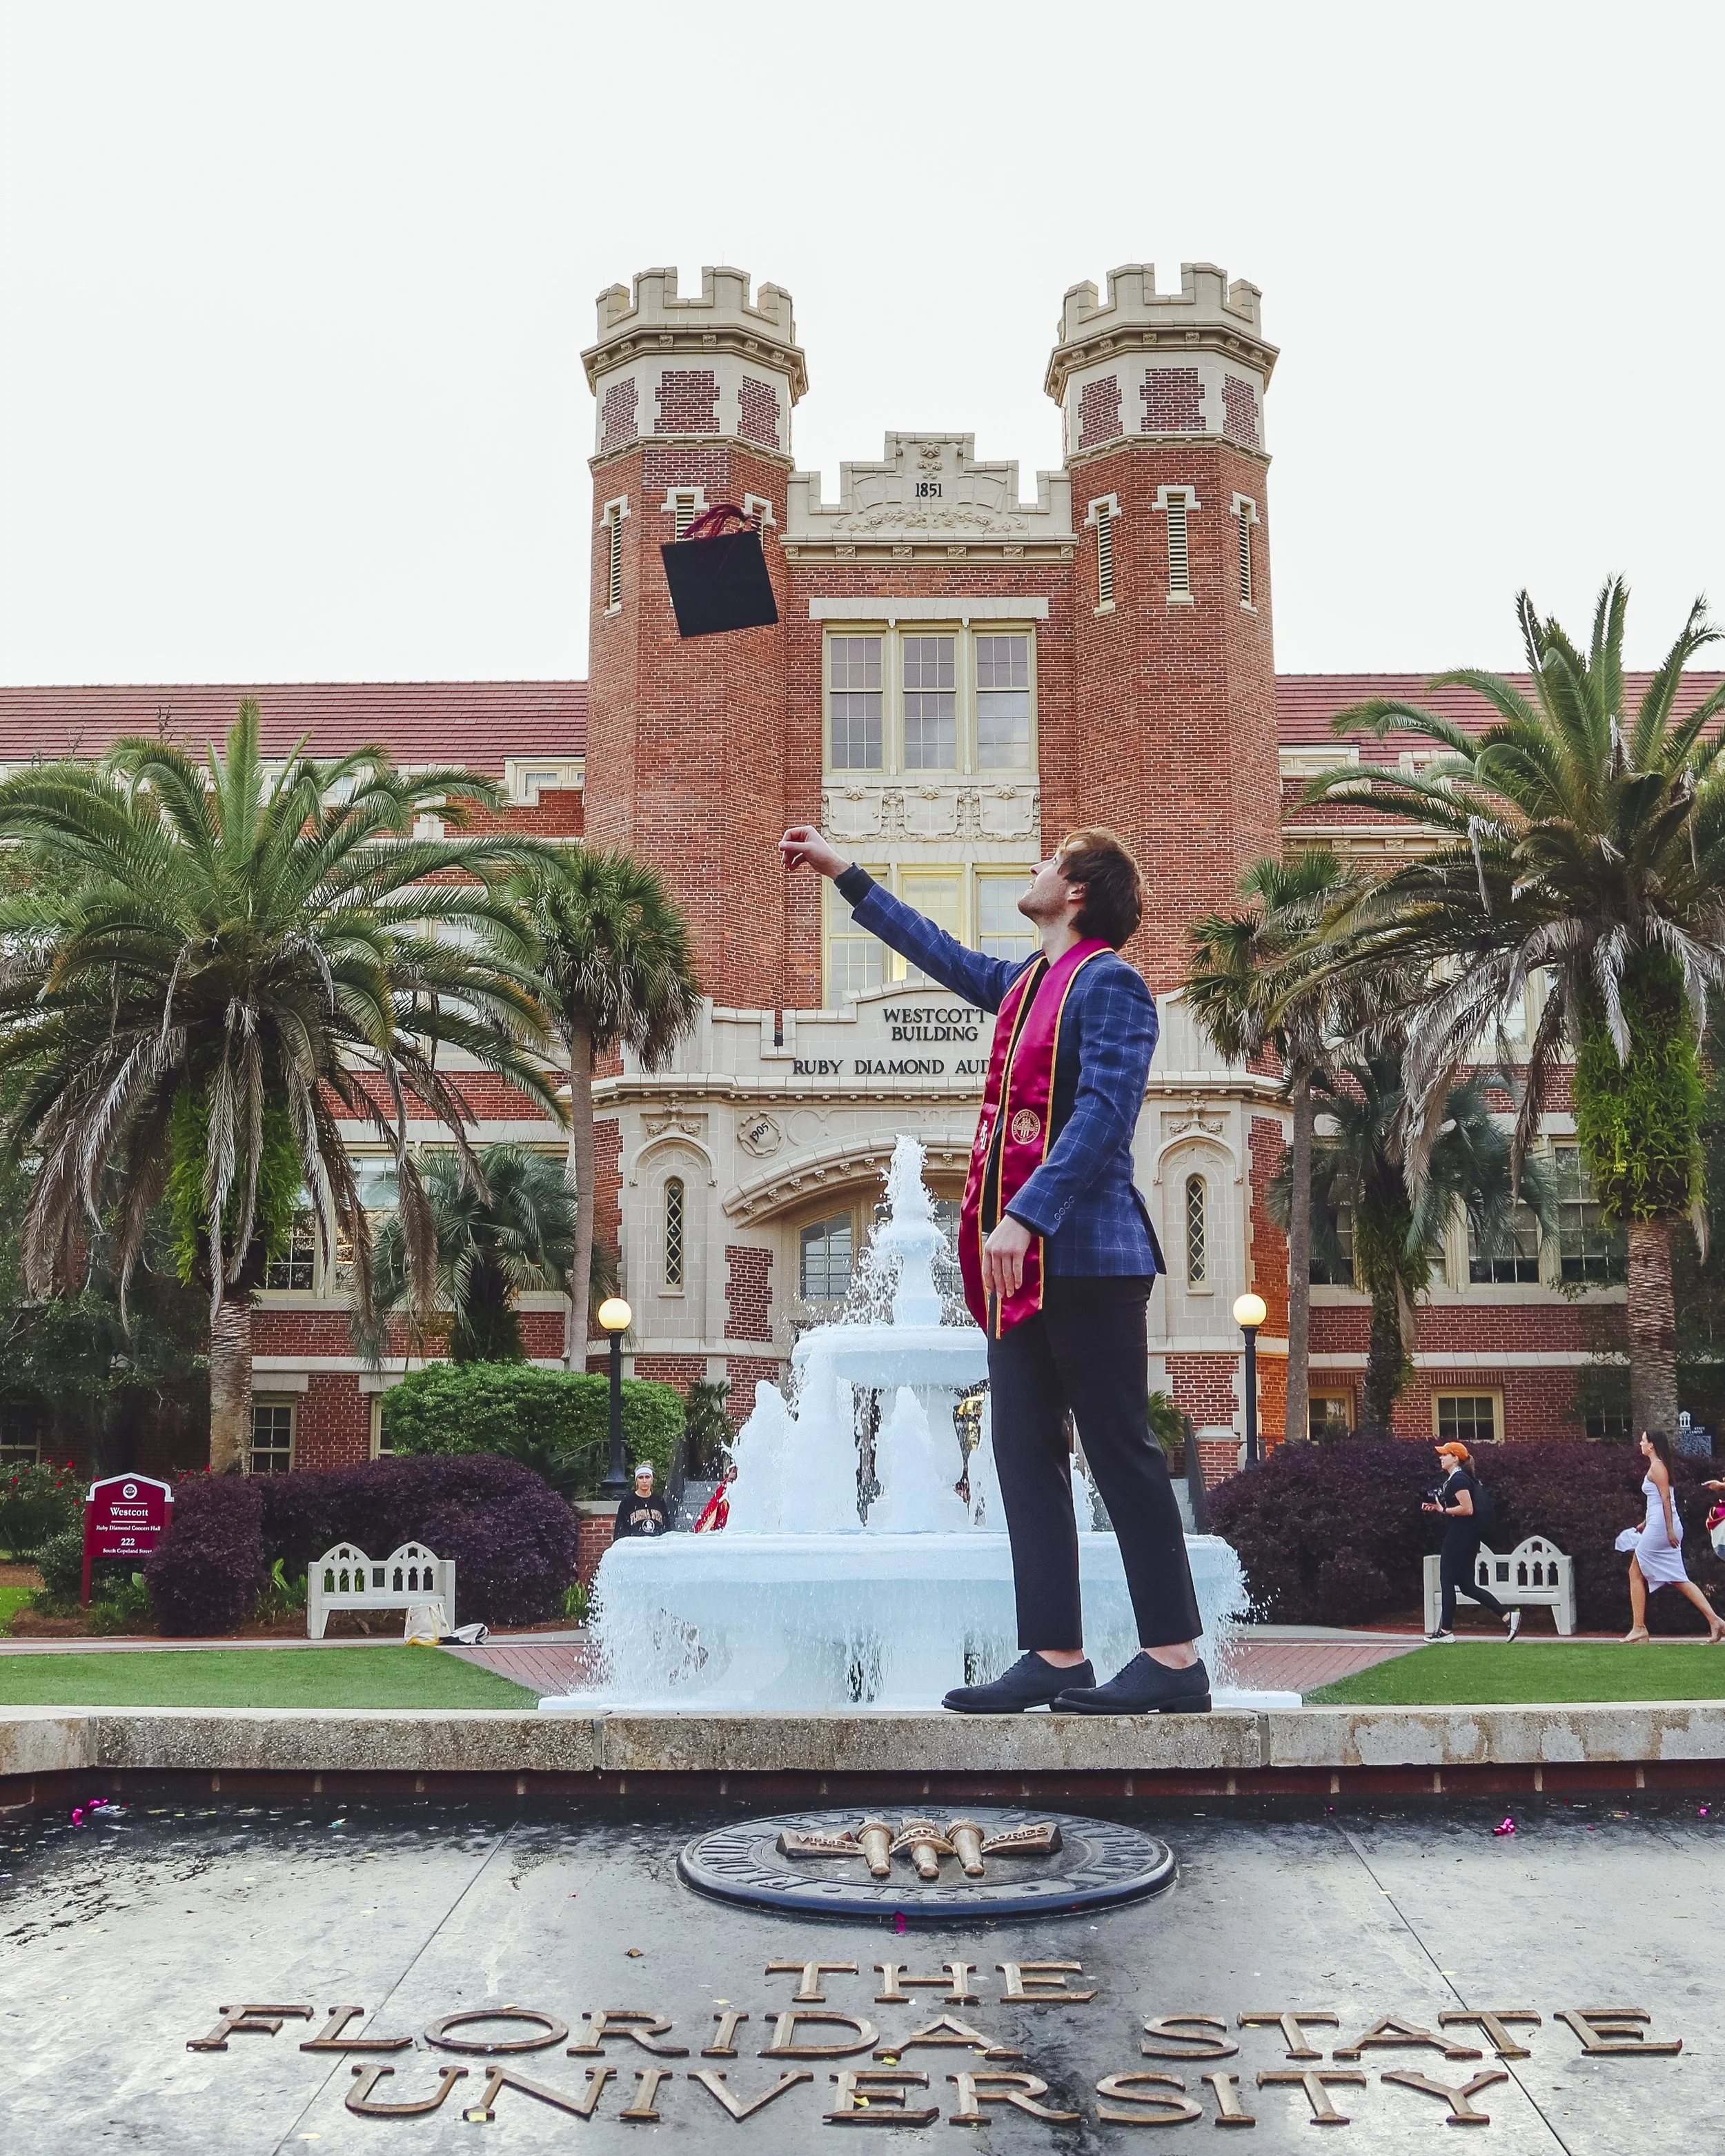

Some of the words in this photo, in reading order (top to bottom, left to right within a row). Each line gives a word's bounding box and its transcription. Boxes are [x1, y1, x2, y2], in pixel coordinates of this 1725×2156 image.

[915, 482, 943, 497] 1851
[883, 1008, 985, 1024] WESTCOTT
[891, 1026, 978, 1041] BUILDING
[793, 1060, 844, 1074] RUBY
[854, 1059, 945, 1074] DIAMOND
[749, 1122, 769, 1144] 1905
[110, 1507, 148, 1516] Westcott
[120, 1538, 135, 1546] 222
[796, 1834, 858, 1849] VIRES
[980, 1827, 1049, 1849] MORES
[765, 1961, 1100, 2003] THE
[186, 2004, 1023, 2061] FLORIDA
[1140, 2007, 1682, 2060] STATE
[345, 2064, 1509, 2126] UNIVERSITY
